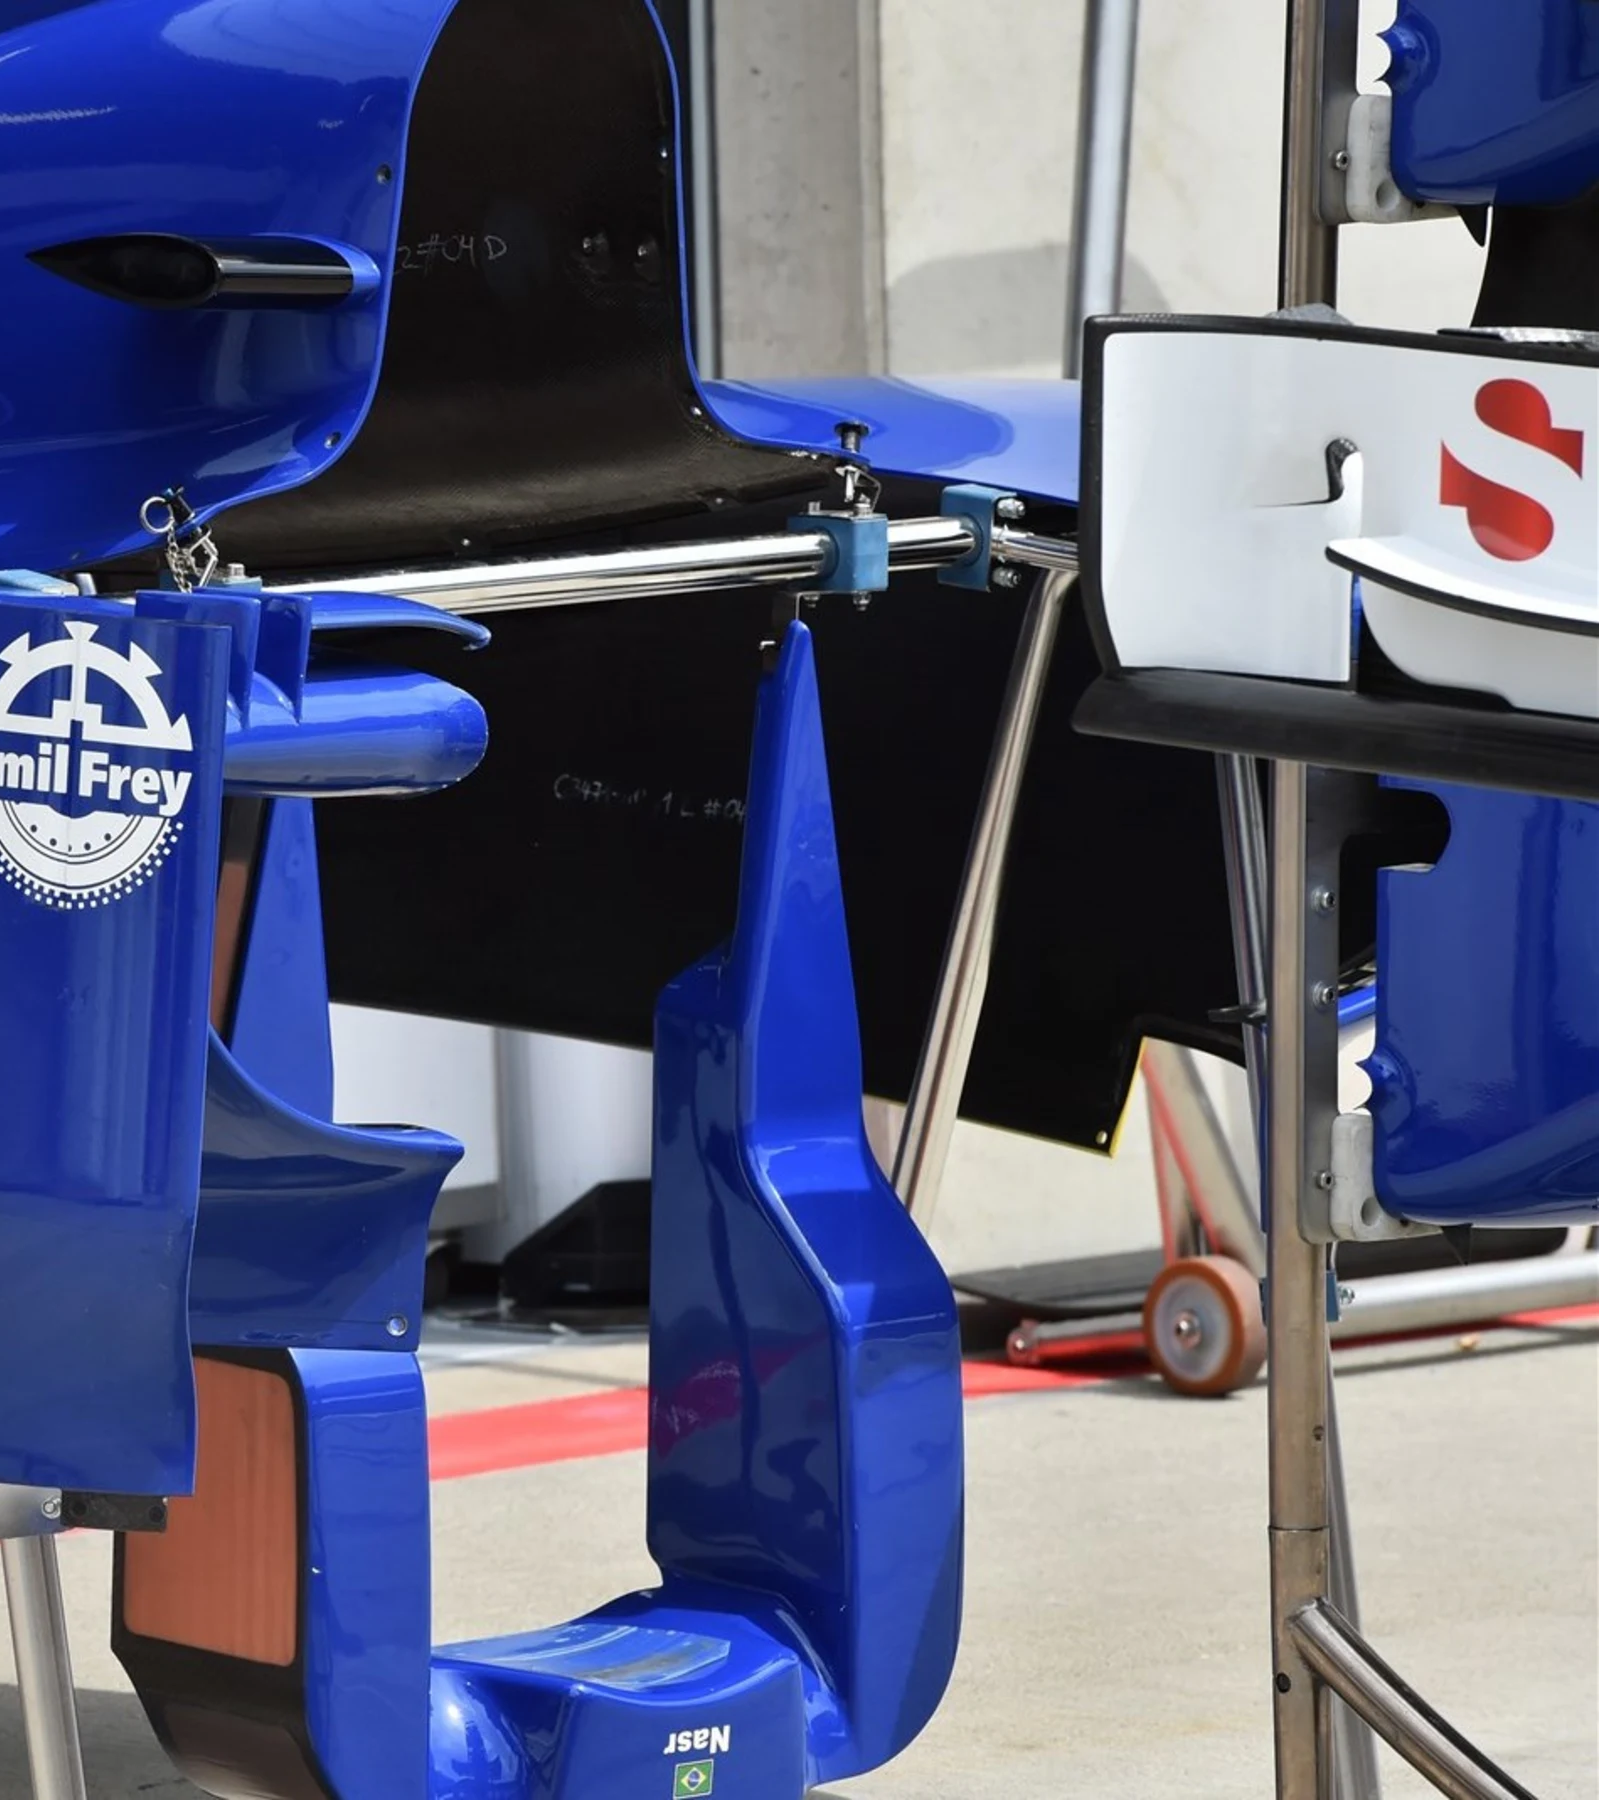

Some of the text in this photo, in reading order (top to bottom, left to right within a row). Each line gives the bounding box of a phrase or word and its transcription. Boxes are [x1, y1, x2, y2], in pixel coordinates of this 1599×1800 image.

[1439, 377, 1585, 562] S
[78, 750, 193, 817] Frey
[663, 1724, 731, 1755] Nasr
